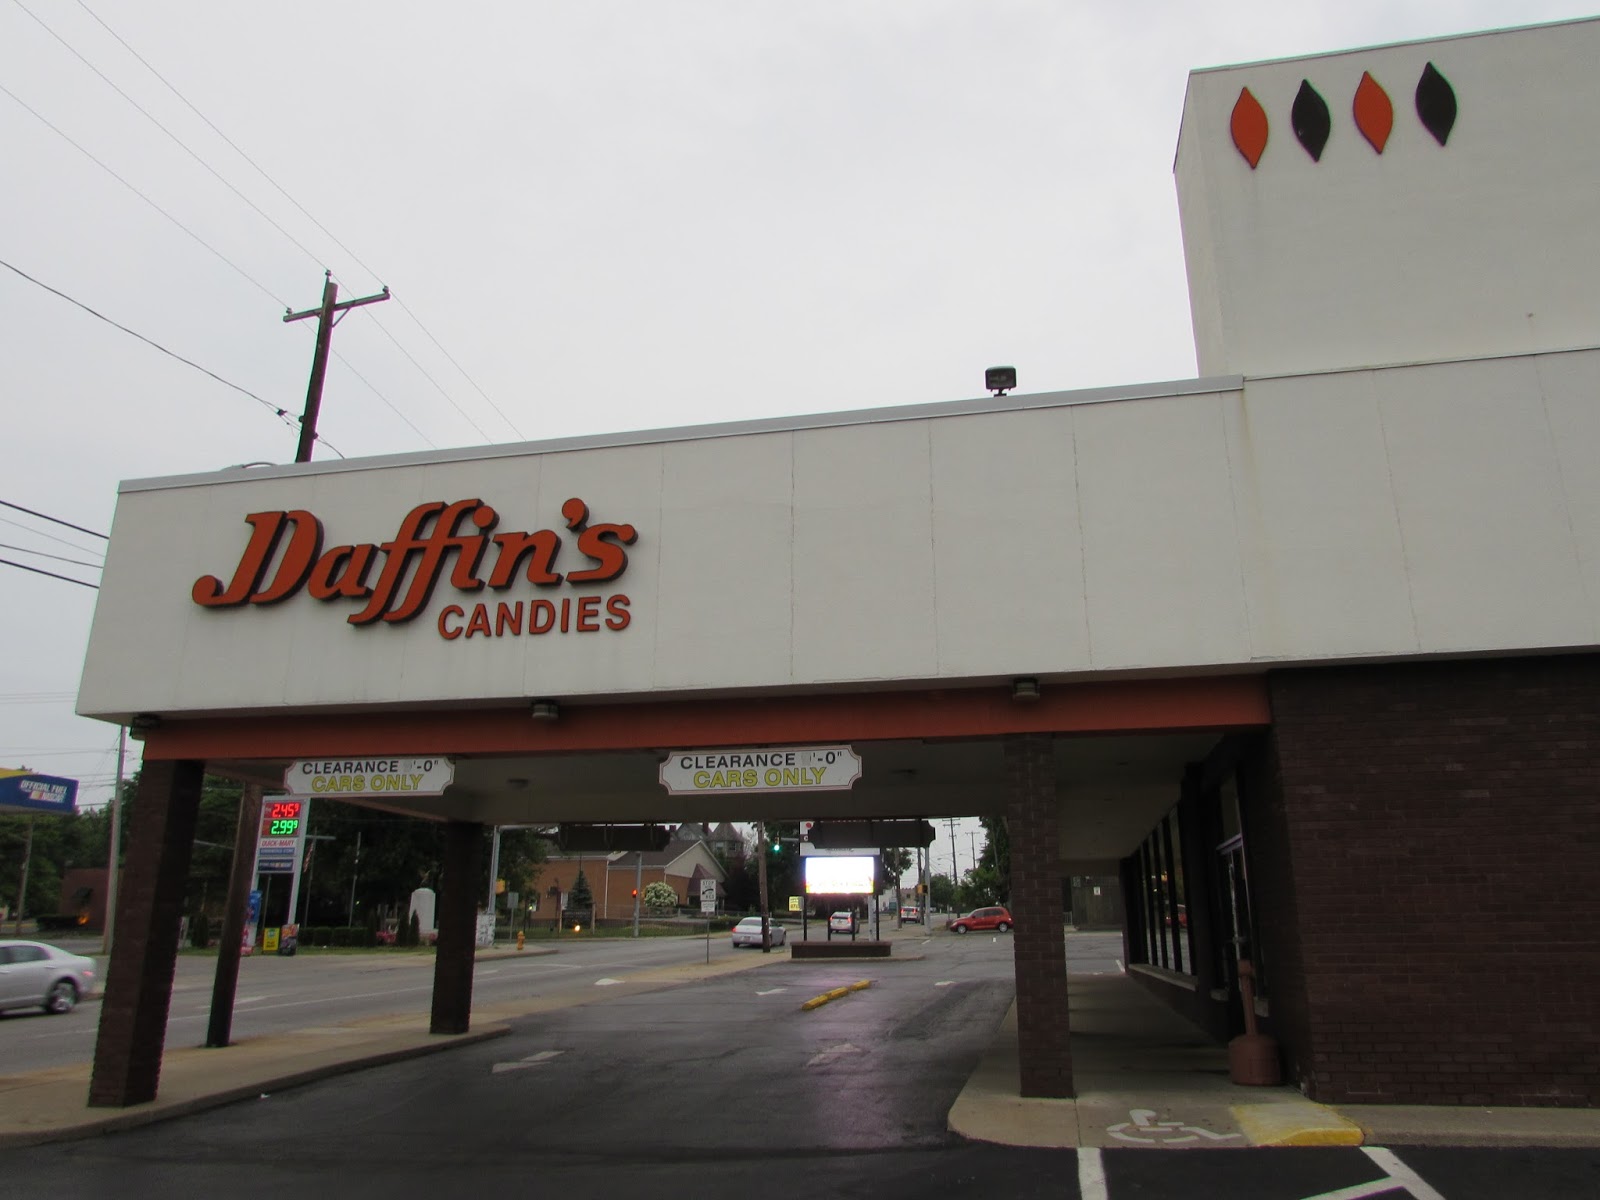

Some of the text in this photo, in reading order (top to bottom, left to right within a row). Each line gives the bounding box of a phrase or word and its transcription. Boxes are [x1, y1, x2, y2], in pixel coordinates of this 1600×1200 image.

[192, 498, 638, 628] Daffin's
[437, 594, 631, 640] CANDIES
[302, 760, 399, 775] CLEARANCE
[680, 753, 796, 770] CLEARANCE
[21, 780, 50, 792] OFFICIAL
[311, 774, 423, 792] CARS ONLY
[693, 767, 827, 788] CARS ONLY
